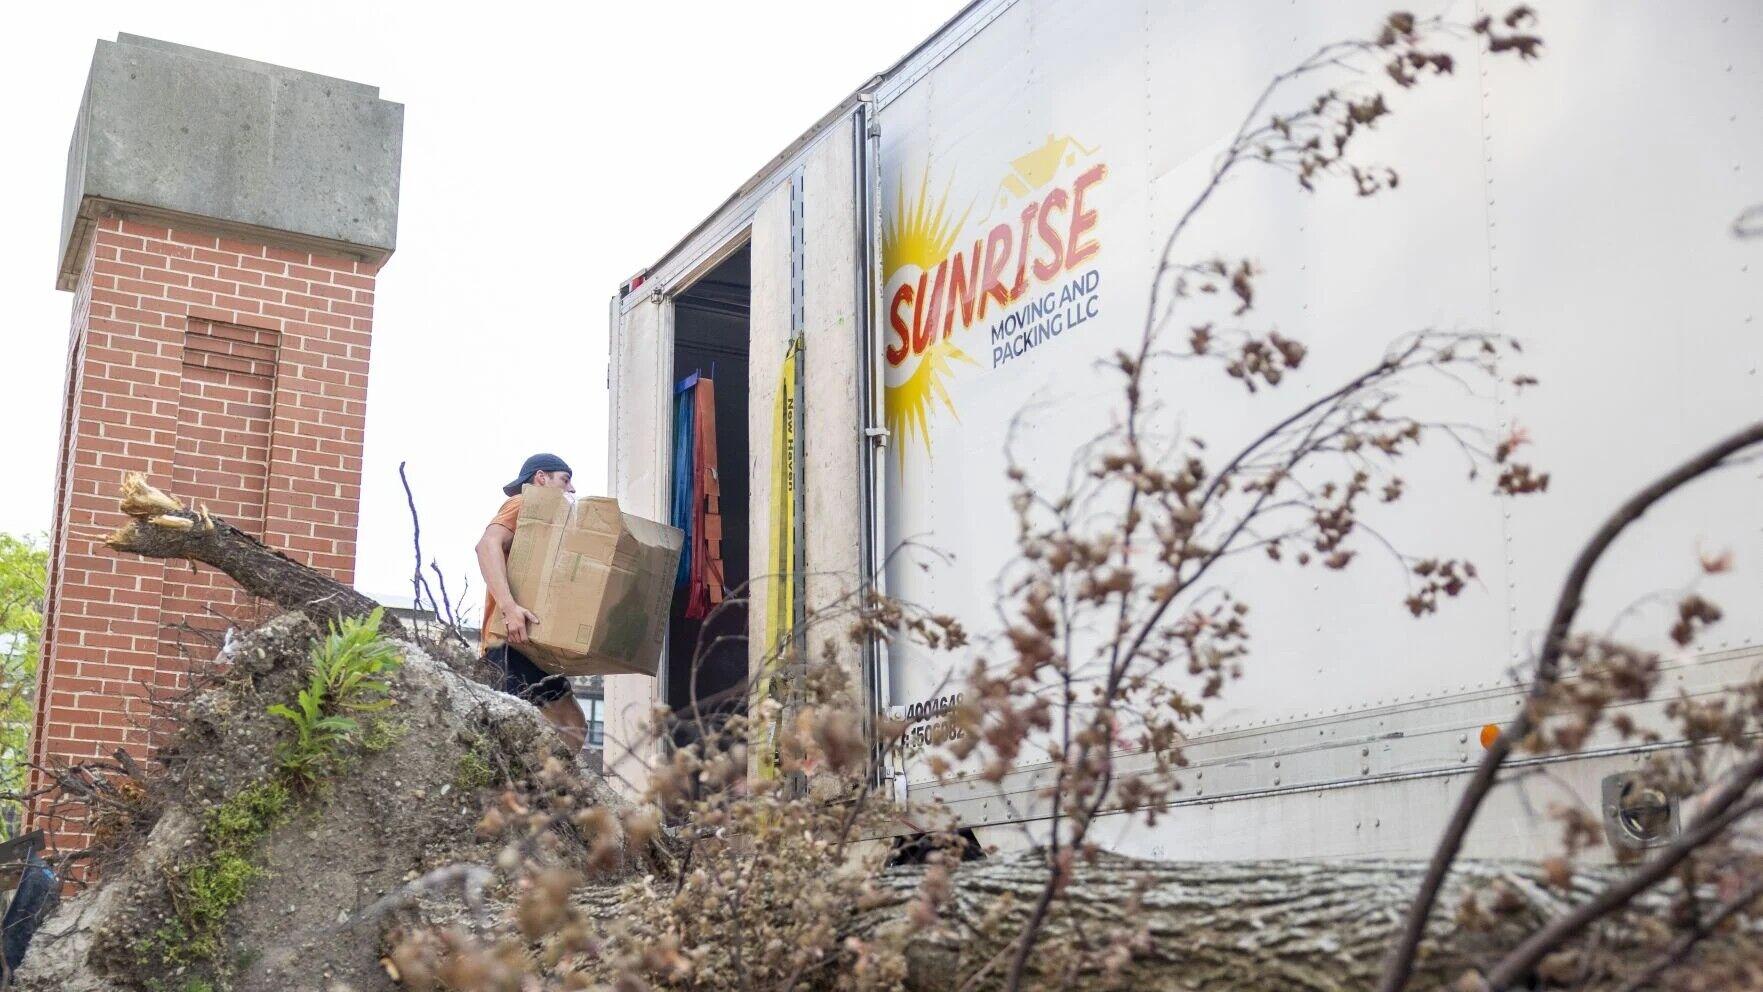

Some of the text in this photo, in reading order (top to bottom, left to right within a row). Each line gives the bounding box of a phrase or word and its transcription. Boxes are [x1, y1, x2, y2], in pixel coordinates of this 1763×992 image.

[886, 163, 1108, 367] SUNRISE
[991, 269, 1100, 345] MOVING AND
[993, 295, 1099, 369] PACKING LLC
